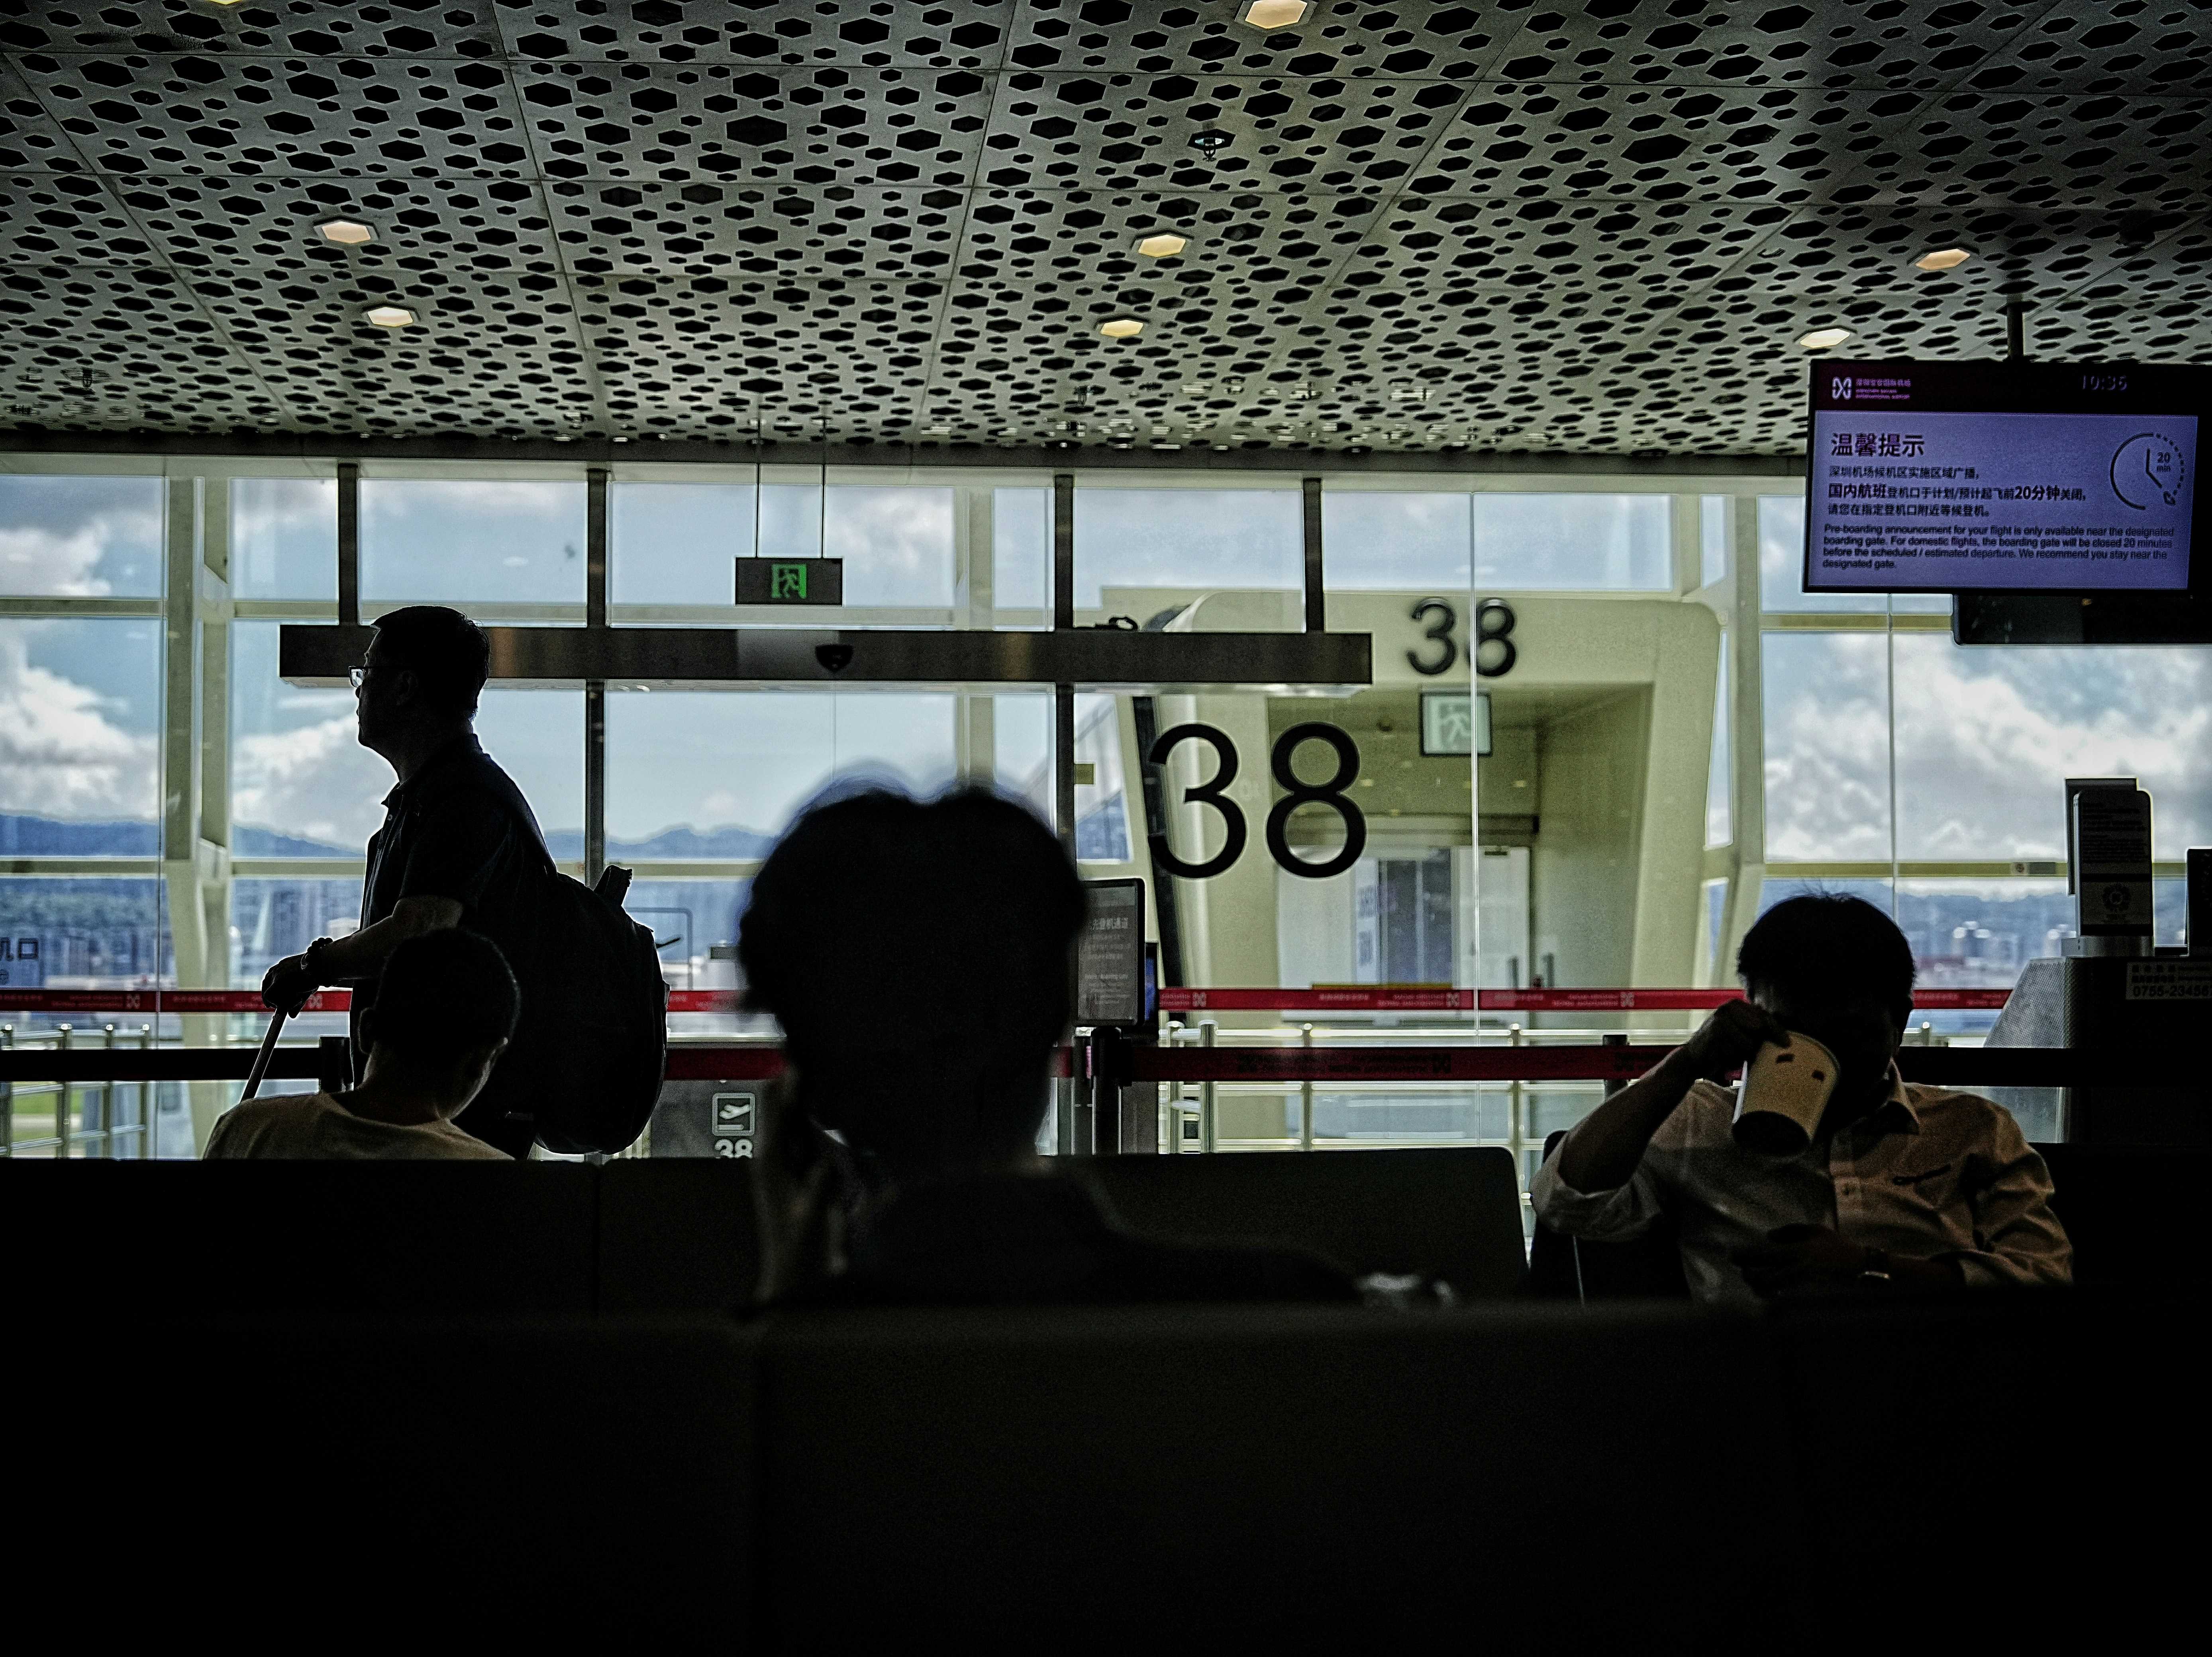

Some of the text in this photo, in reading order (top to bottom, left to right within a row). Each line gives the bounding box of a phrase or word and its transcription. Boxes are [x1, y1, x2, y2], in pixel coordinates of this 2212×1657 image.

[1831, 432, 1925, 457] 温馨提示
[2157, 452, 2170, 462] 20
[1824, 523, 1882, 536] Pre-boarding
[1954, 525, 1967, 534] for
[1969, 527, 1988, 536] your
[1990, 525, 2011, 537] flight
[2014, 526, 2021, 535] is
[2024, 525, 2043, 537] only
[2045, 526, 2084, 536] available
[2086, 527, 2107, 536] near
[2109, 527, 2123, 536] the
[2125, 527, 2174, 538] designated
[1824, 537, 1863, 547] boarding
[1890, 536, 1906, 546] For
[1908, 537, 1948, 546] domestic
[1983, 537, 1997, 546] the
[1999, 537, 2038, 548] boarding
[2040, 539, 2060, 549] gate
[2063, 538, 2077, 547] will
[2079, 538, 2090, 547] be
[2092, 539, 2122, 548] closed
[2124, 538, 2136, 548] 20
[2137, 539, 2172, 548] minutes
[1823, 547, 1853, 556] before
[1855, 548, 1869, 557] the
[1871, 548, 1918, 557] scheduled
[1925, 548, 1969, 558] estimated
[2019, 549, 2034, 558] We
[2036, 549, 2088, 558] recommend
[2091, 550, 2107, 561] you
[2110, 550, 2128, 561] stay
[2130, 550, 2151, 559] near
[2153, 550, 2168, 559] the
[1823, 559, 1872, 570] designated
[1405, 597, 1517, 677] 38
[1147, 722, 1367, 879] 38
[714, 1138, 753, 1159] 38
